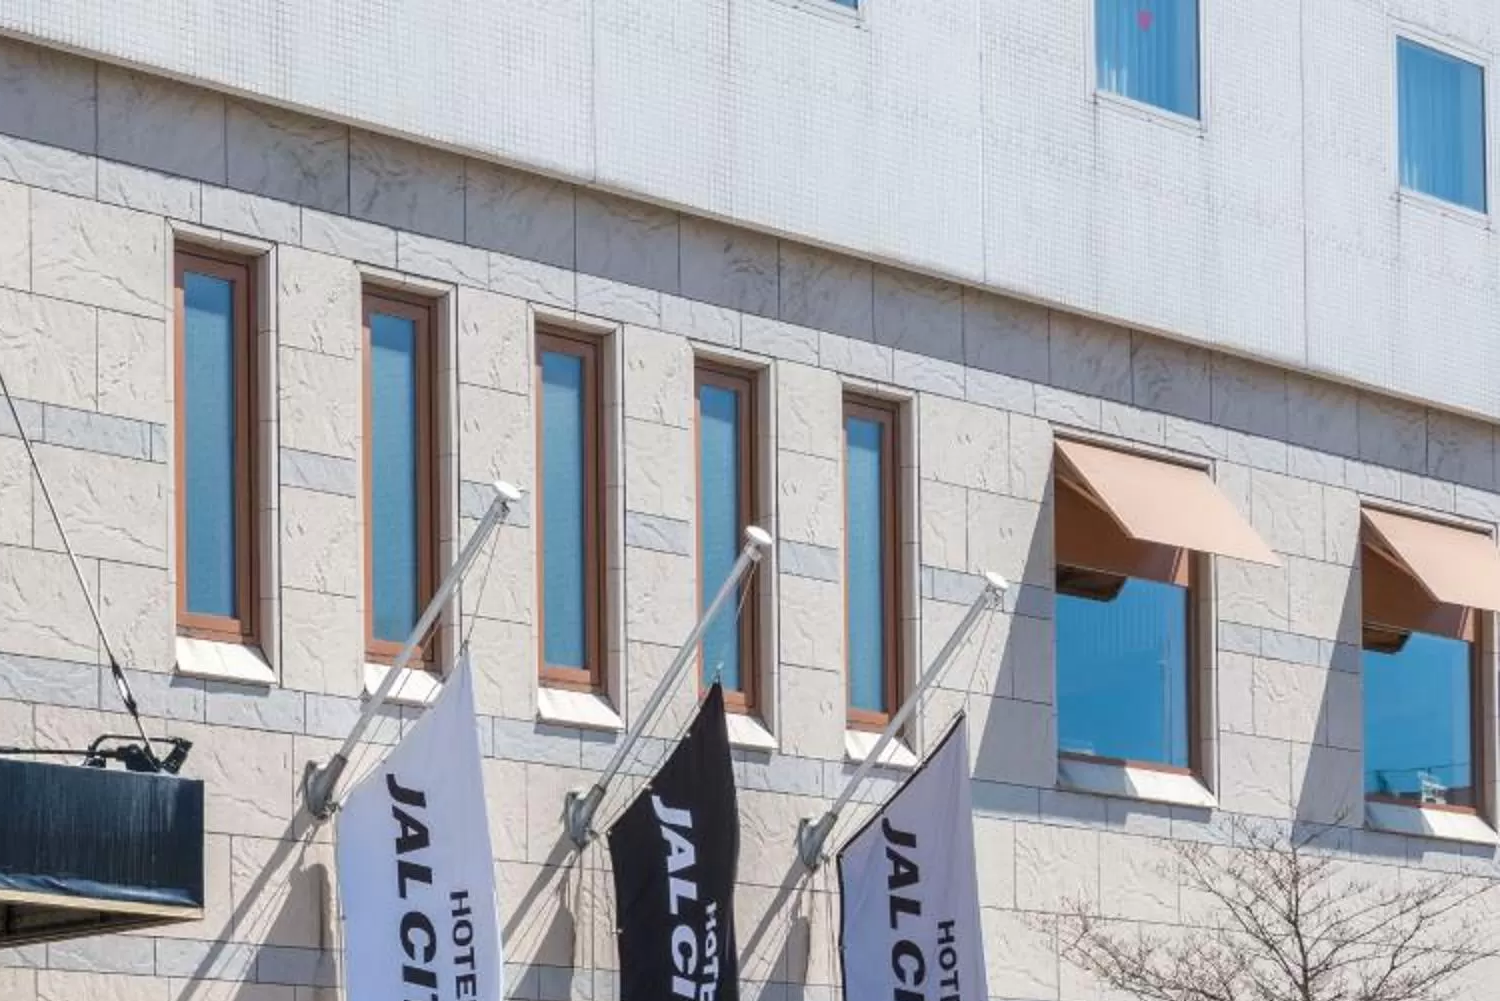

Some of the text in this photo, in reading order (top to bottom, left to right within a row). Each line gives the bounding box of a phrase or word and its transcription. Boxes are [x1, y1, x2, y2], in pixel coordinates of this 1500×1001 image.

[386, 773, 434, 899] JAL
[651, 795, 698, 915] JAL
[882, 817, 921, 930] JAL
